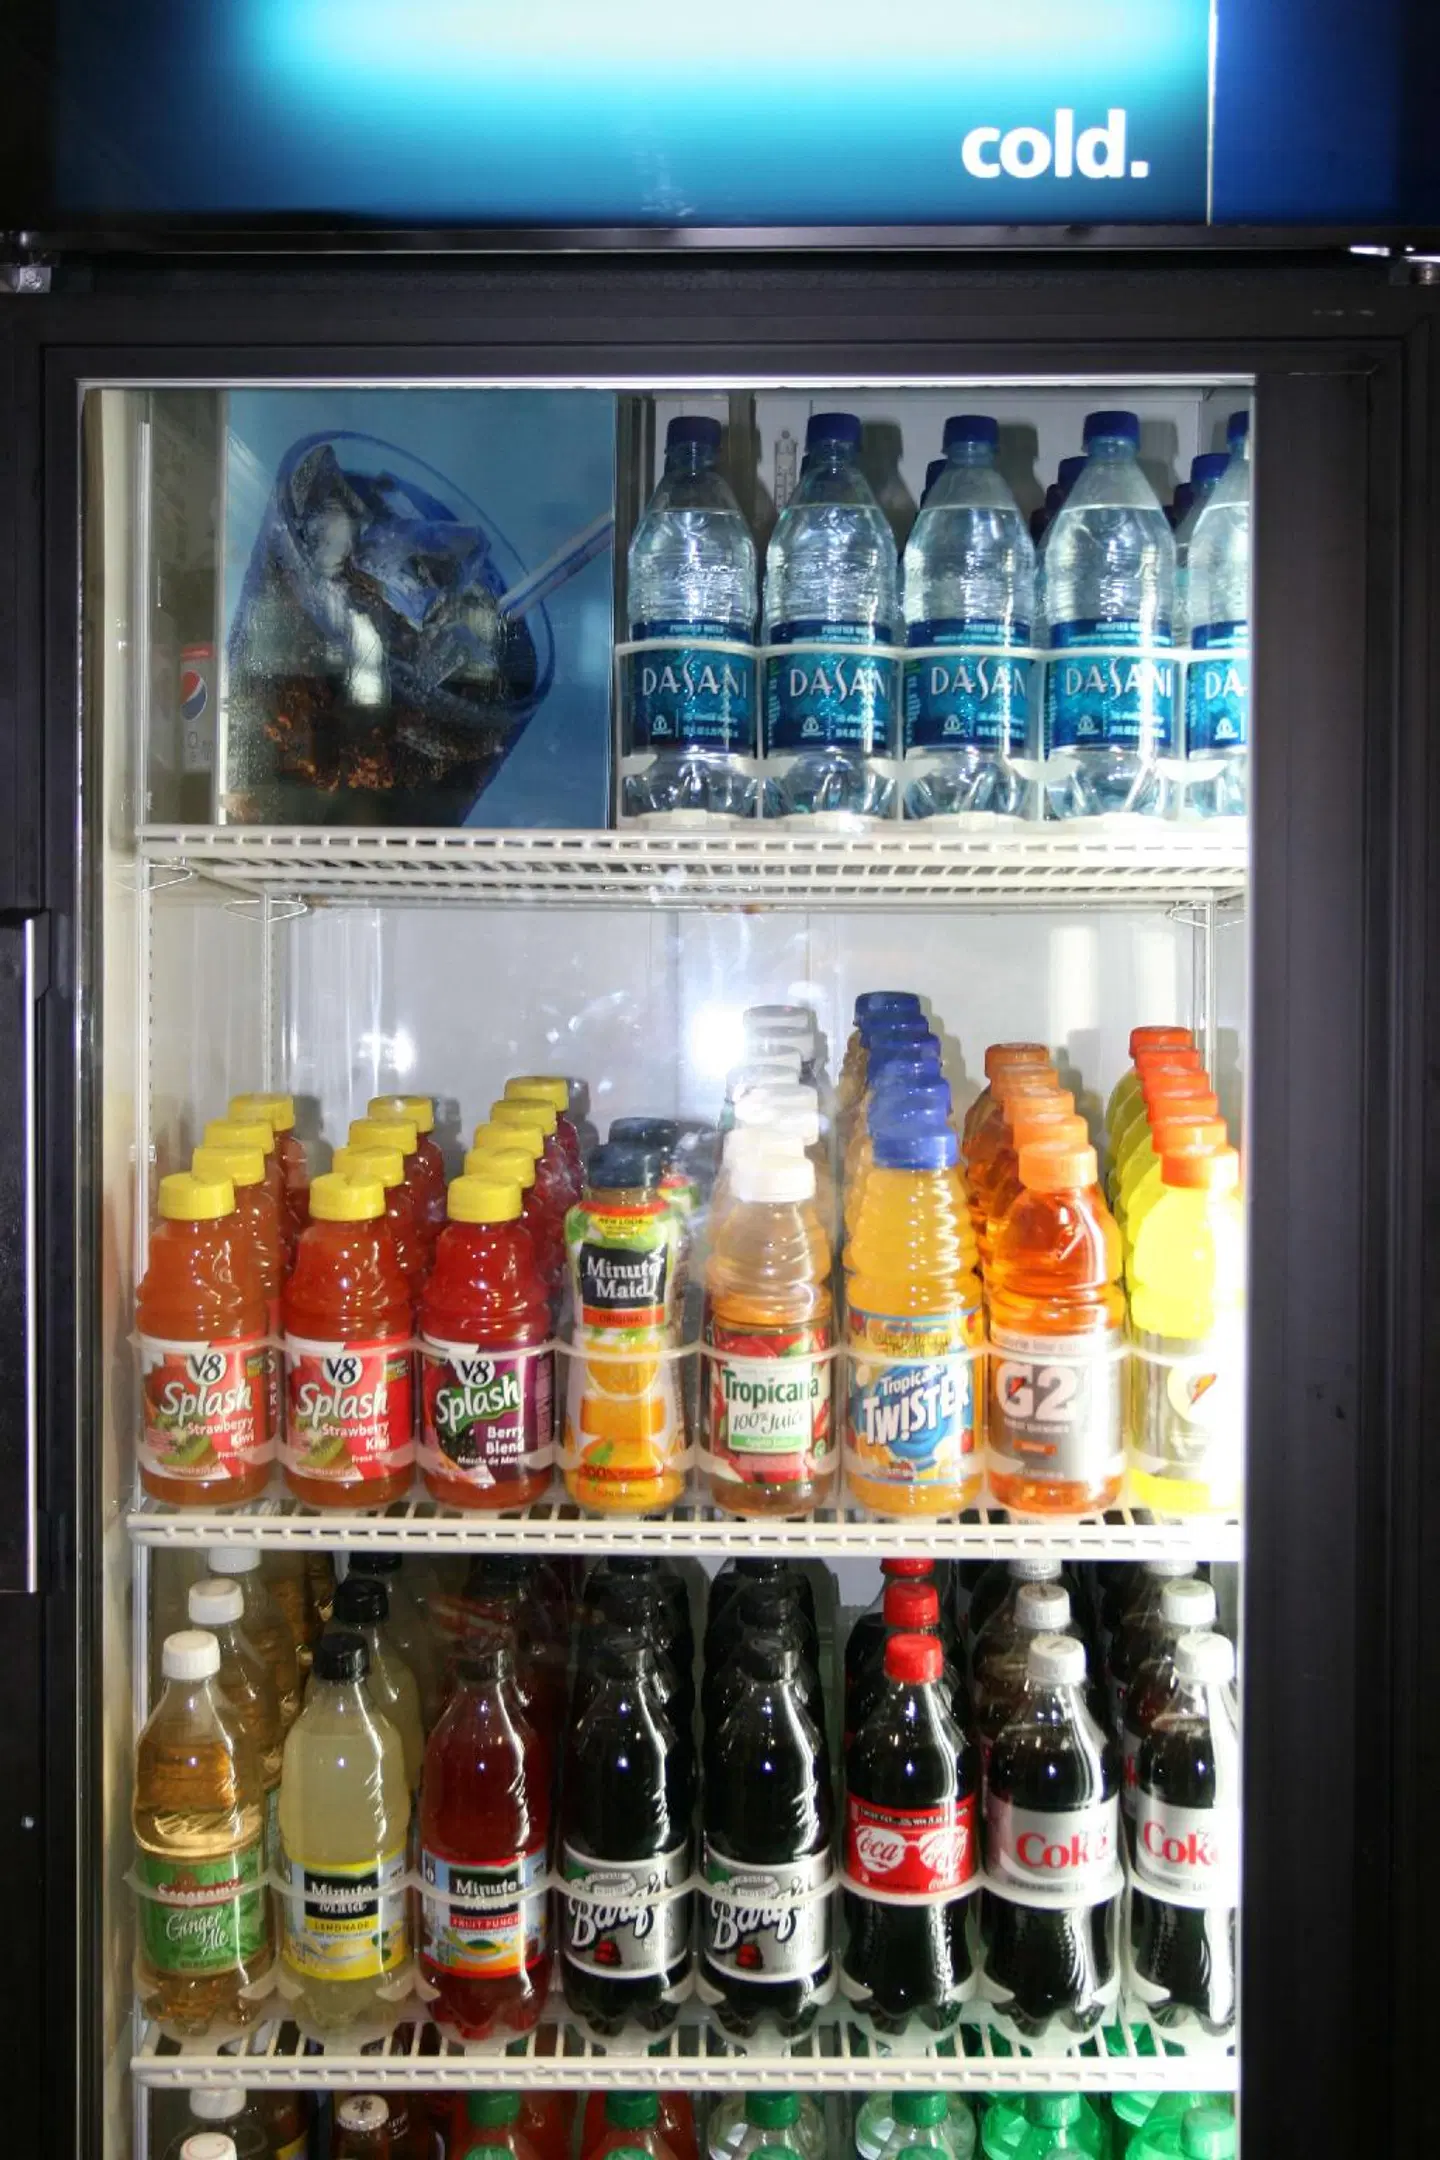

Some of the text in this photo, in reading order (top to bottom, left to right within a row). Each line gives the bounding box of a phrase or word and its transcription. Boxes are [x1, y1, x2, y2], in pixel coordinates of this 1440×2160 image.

[962, 108, 1149, 178] cold.
[642, 653, 747, 701] DASANI
[789, 656, 885, 702] DASAN
[931, 656, 1026, 701] DASAN
[1065, 656, 1171, 700] DASANI
[587, 1254, 661, 1280] Minute
[596, 1278, 652, 1299] Maid
[189, 1352, 222, 1381] V8
[326, 1357, 357, 1386] V8
[460, 1359, 490, 1385] V8
[160, 1381, 252, 1427] Splash
[296, 1382, 388, 1428] Splash
[436, 1374, 521, 1433] Splash
[996, 1361, 1078, 1422] G2
[187, 1417, 254, 1436] Strawberry
[321, 1421, 389, 1438] Strawberry
[487, 1425, 524, 1439] Berry
[485, 1440, 525, 1454] Blend
[456, 1879, 517, 1897] Minute
[166, 1909, 224, 1943] Ginger
[314, 1920, 370, 1932] LEMONADE
[202, 1926, 229, 1956] Ale
